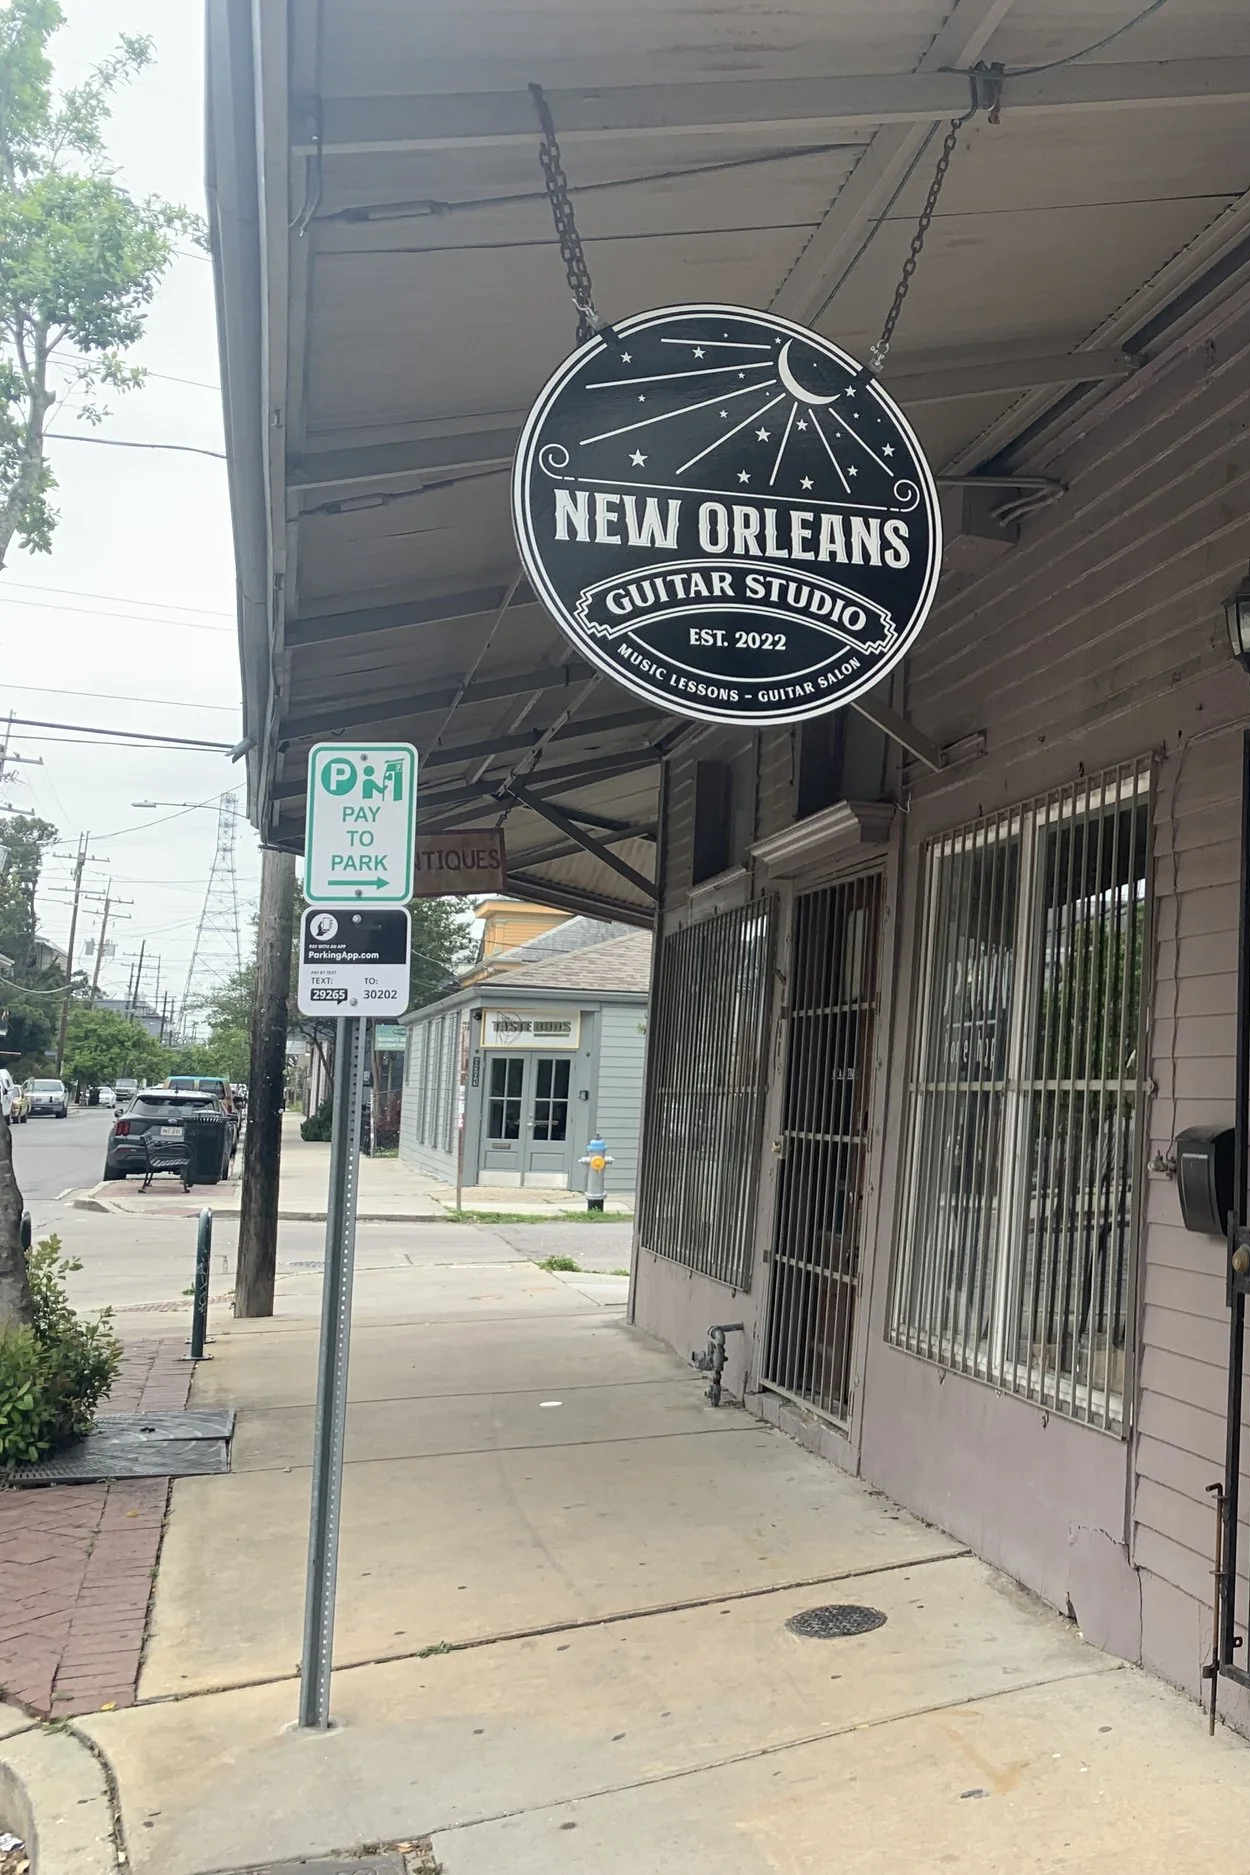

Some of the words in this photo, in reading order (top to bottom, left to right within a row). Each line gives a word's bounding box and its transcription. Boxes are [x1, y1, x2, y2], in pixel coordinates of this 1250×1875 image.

[553, 488, 682, 550] NEW
[698, 500, 911, 570] ORLEANS
[605, 572, 735, 615] GUITAR
[745, 573, 867, 631] STUDIO
[689, 628, 728, 647] EST.
[735, 631, 787, 650] 2022
[617, 643, 667, 680] MUSIC
[670, 673, 739, 702] LESSONS
[757, 681, 816, 702] GUITAR
[818, 656, 862, 689] SALON
[342, 806, 381, 823] PAY
[346, 830, 374, 847] TO
[331, 854, 389, 871] PARK
[308, 950, 380, 960] ParkingApp.com
[312, 990, 346, 999] 29265
[363, 989, 398, 999] 30202
